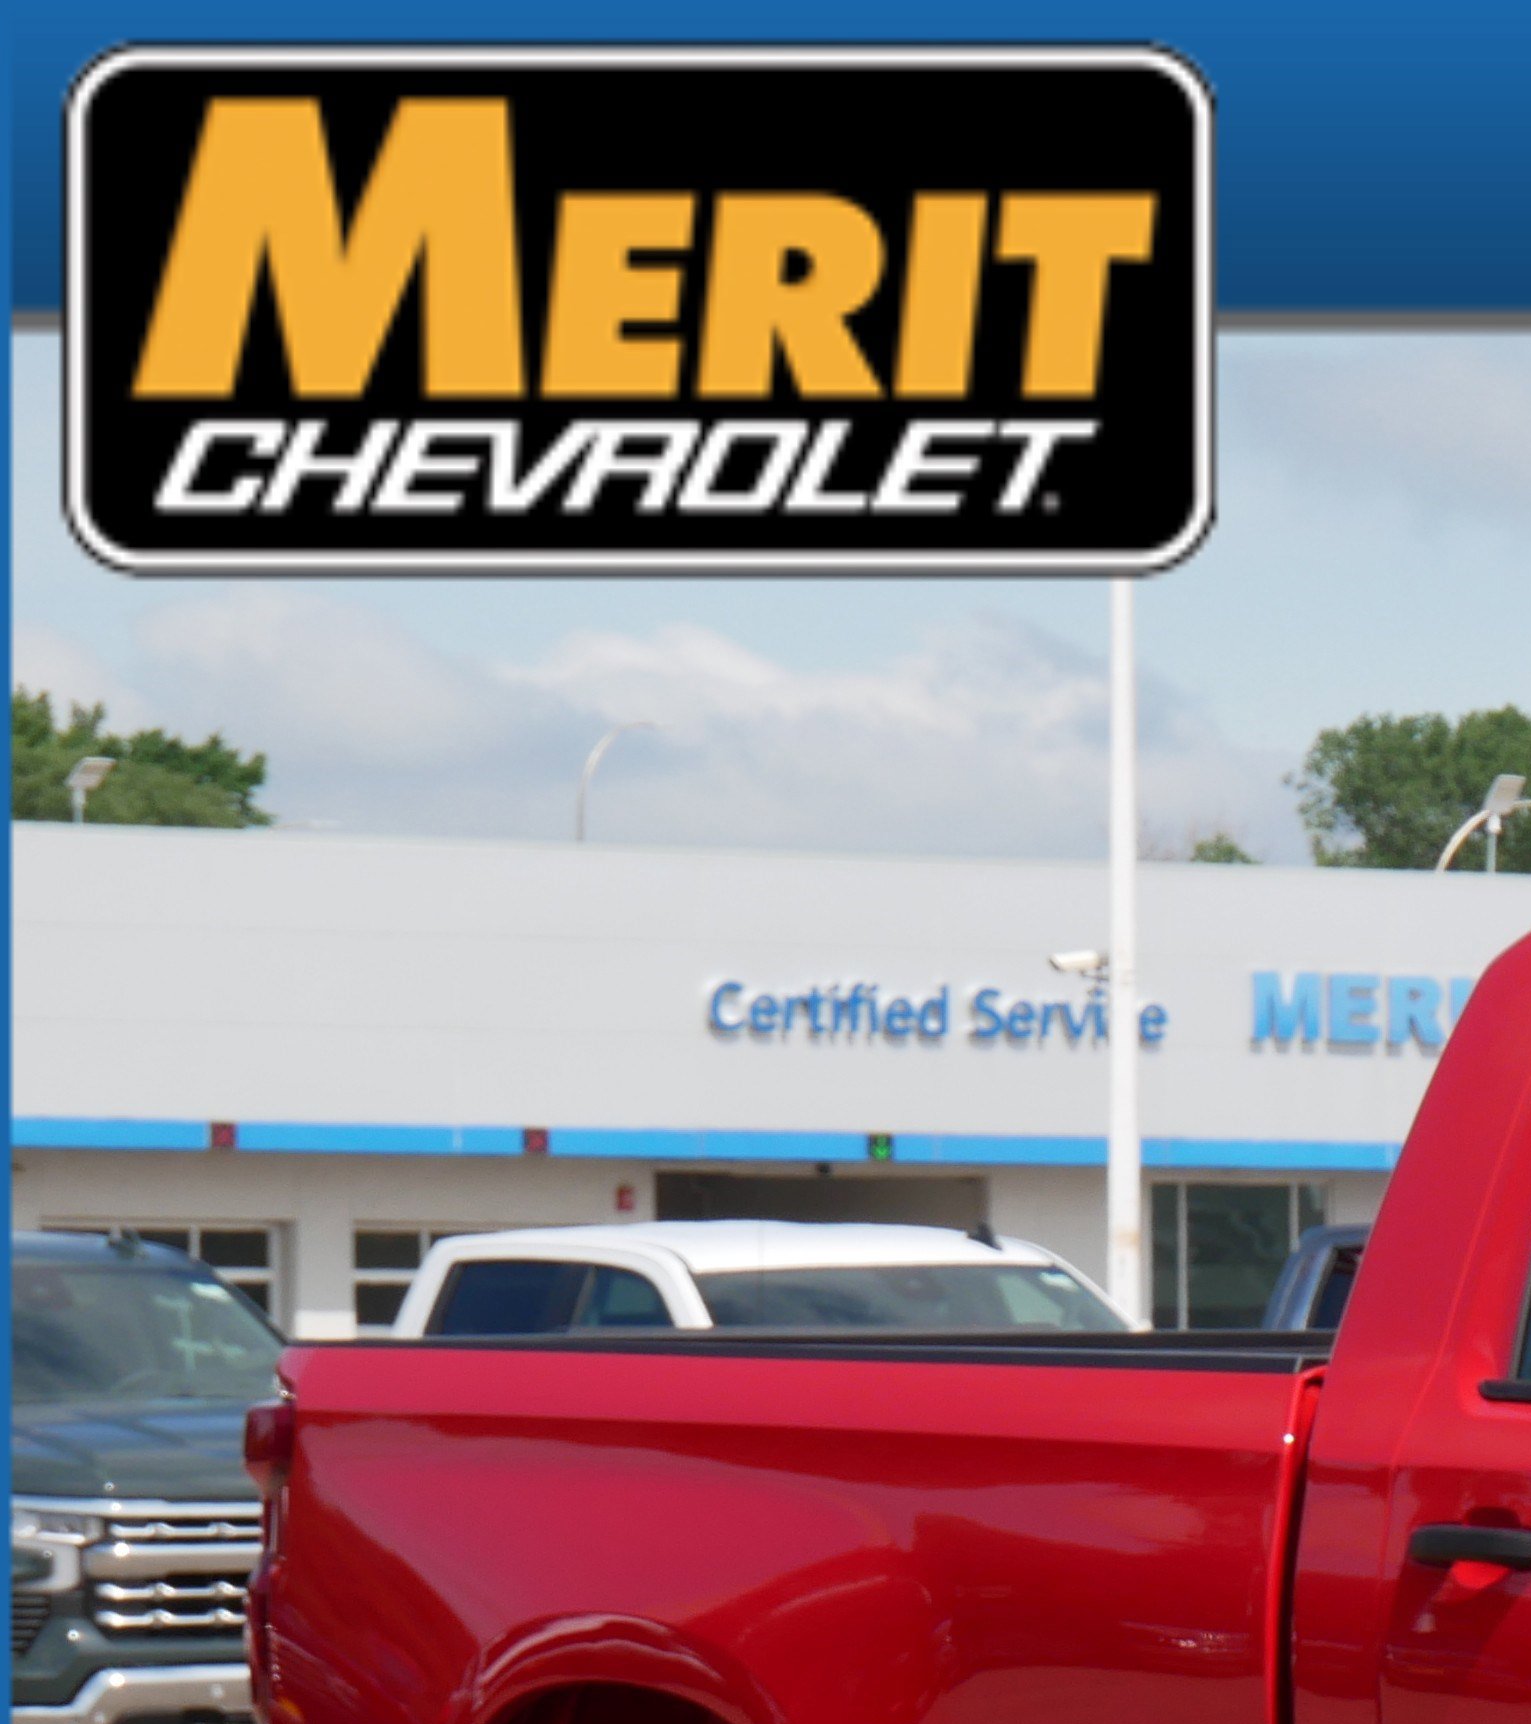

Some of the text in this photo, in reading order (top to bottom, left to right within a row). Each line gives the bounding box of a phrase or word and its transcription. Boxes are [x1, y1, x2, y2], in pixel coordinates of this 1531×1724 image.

[709, 982, 1168, 1041] Certified Servie
[1251, 971, 1475, 1045] MERI
